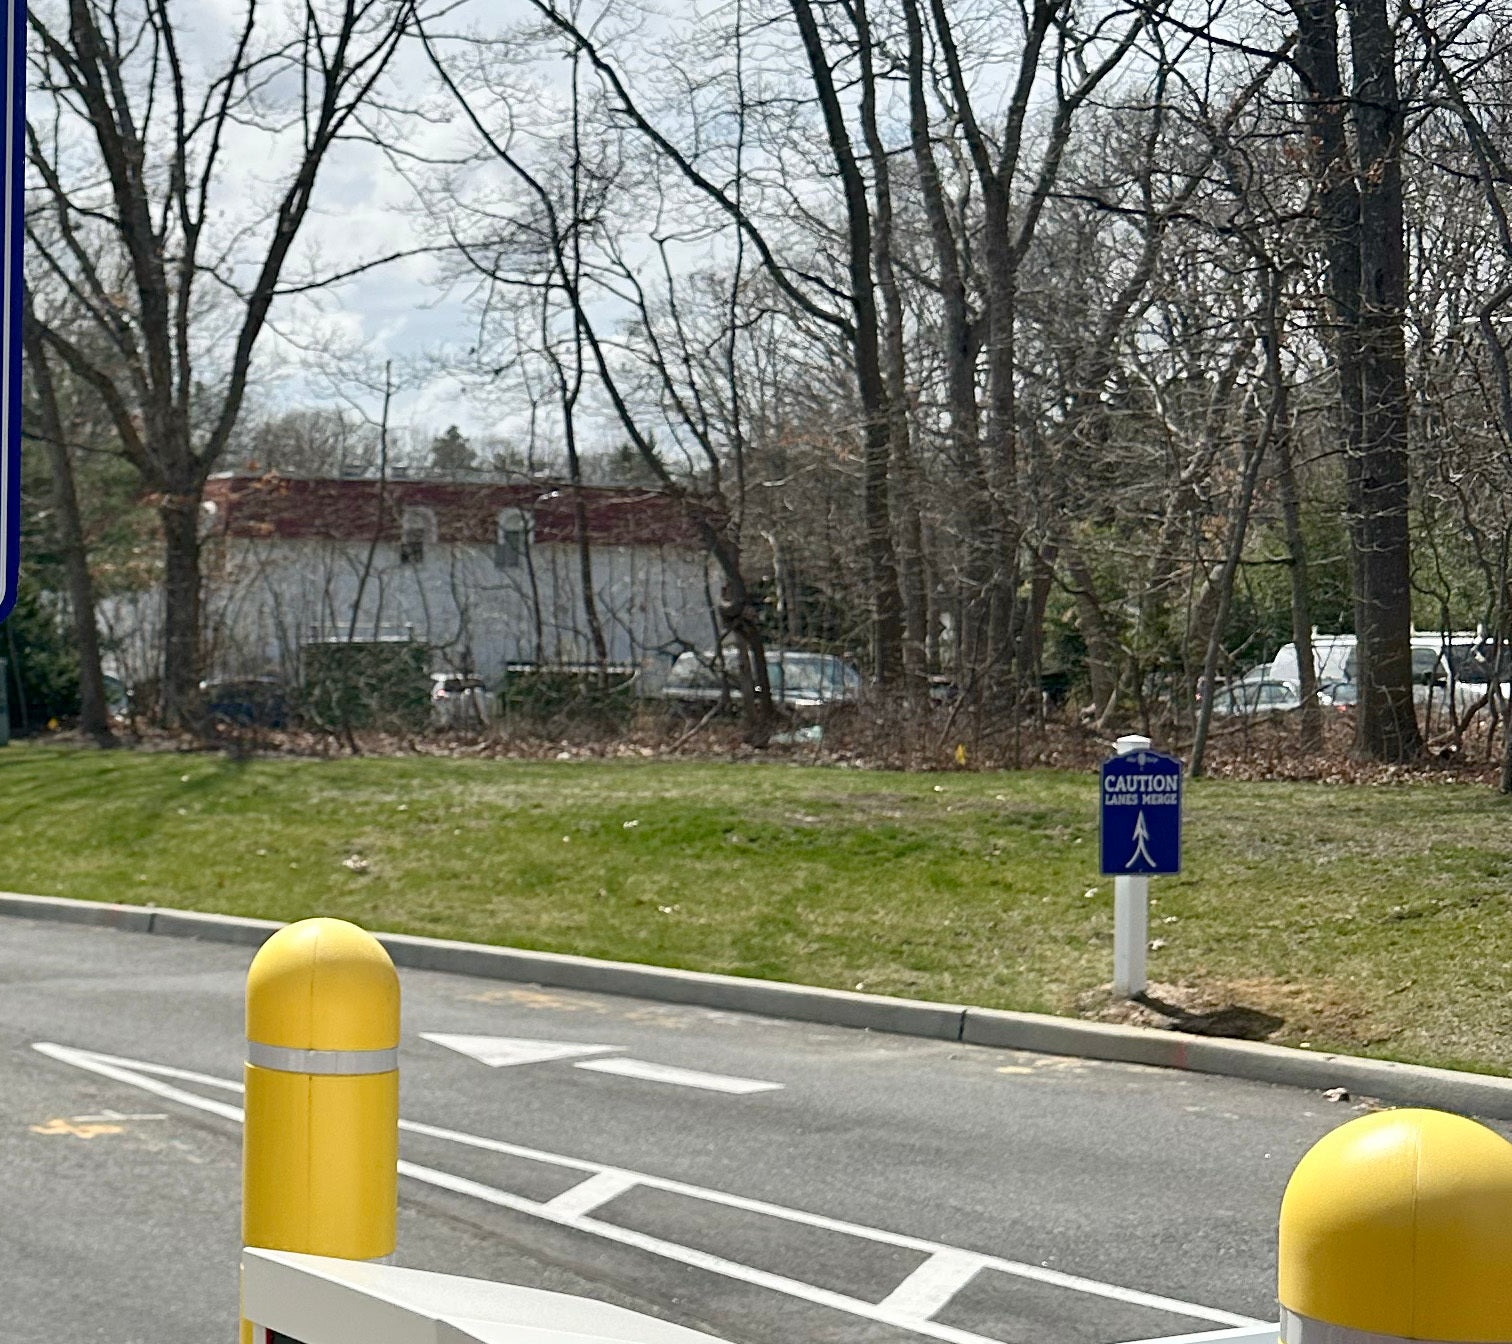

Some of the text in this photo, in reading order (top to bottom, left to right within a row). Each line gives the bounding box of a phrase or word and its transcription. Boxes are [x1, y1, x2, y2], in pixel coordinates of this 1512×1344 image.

[1104, 774, 1179, 792] CAUTION
[1105, 792, 1178, 805] LANES MERGE
